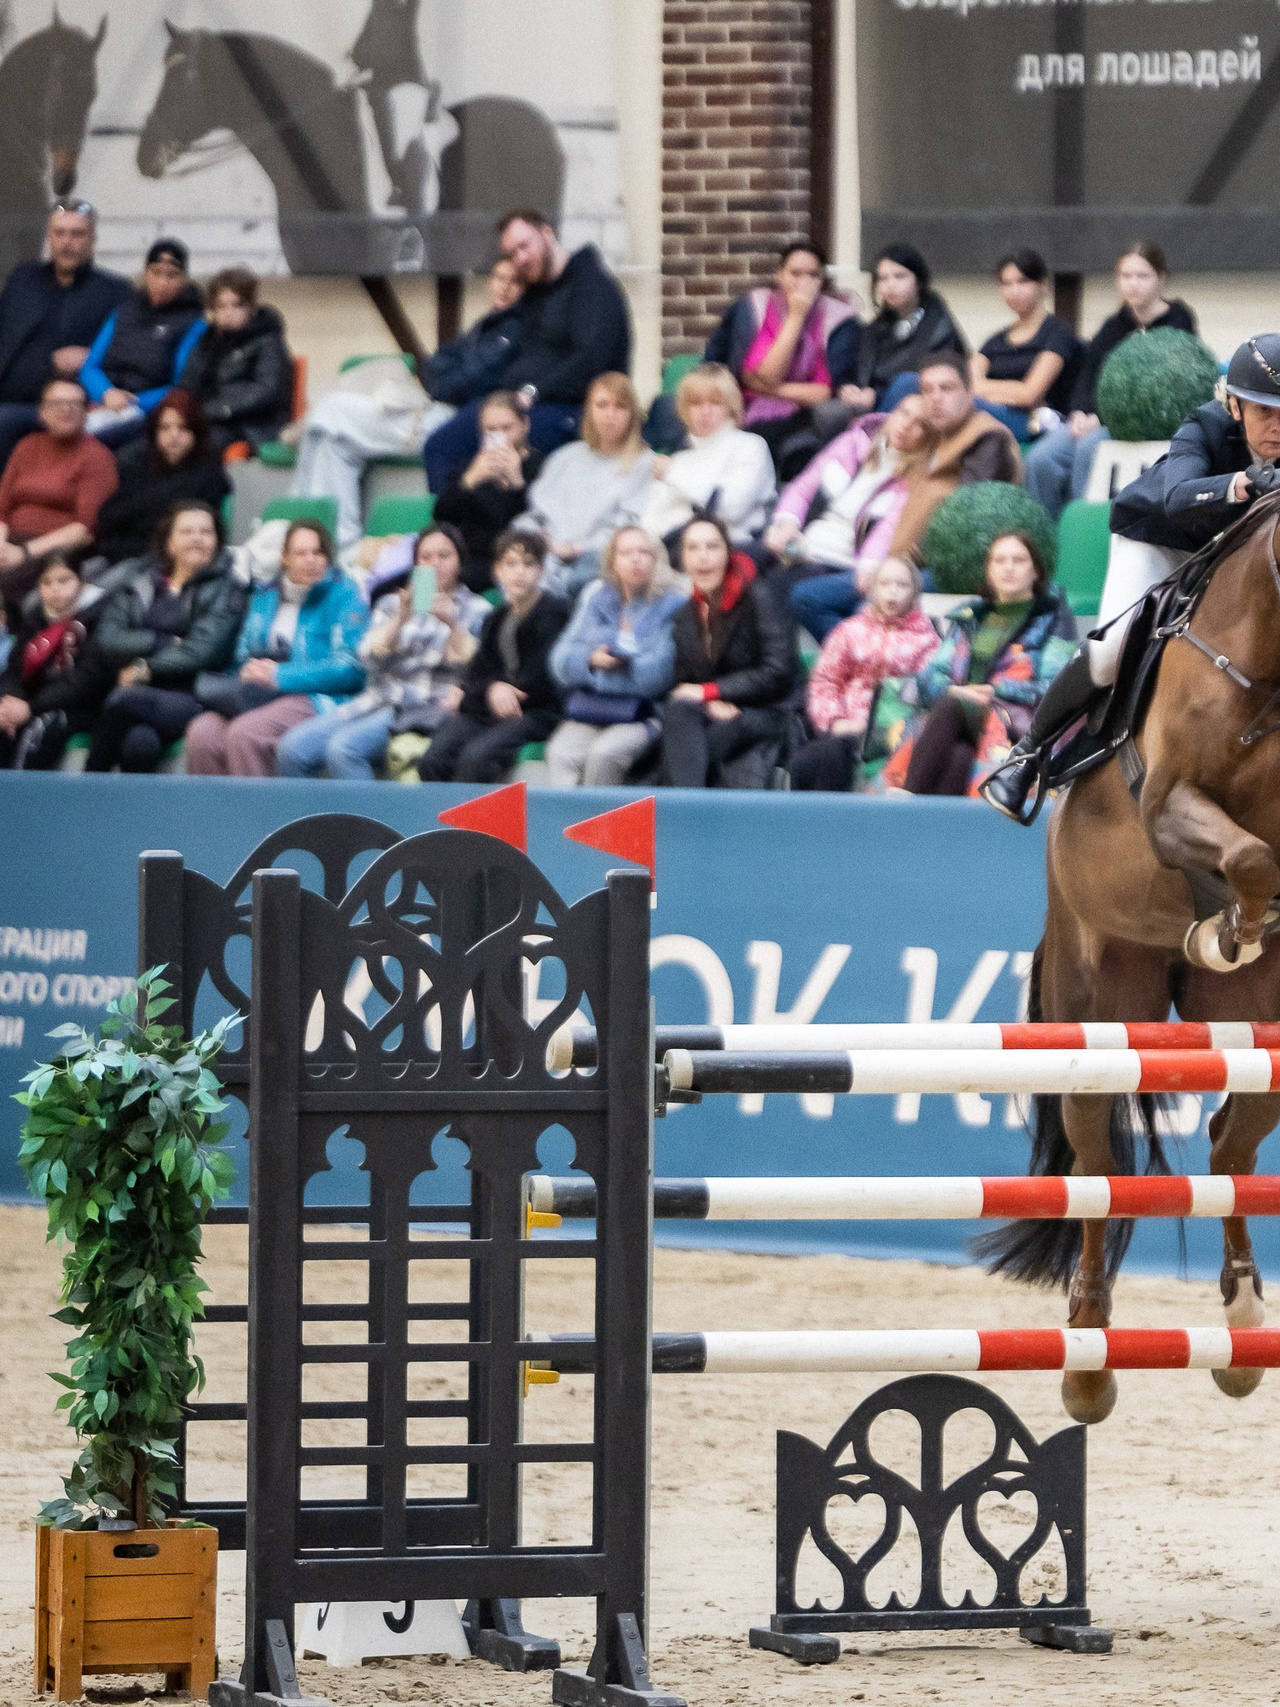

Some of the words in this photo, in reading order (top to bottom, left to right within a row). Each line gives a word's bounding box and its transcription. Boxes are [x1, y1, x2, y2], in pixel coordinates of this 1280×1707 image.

[1017, 53, 1085, 92] для
[1096, 35, 1262, 90] лошадей
[0, 926, 88, 965] РАЦИЯ
